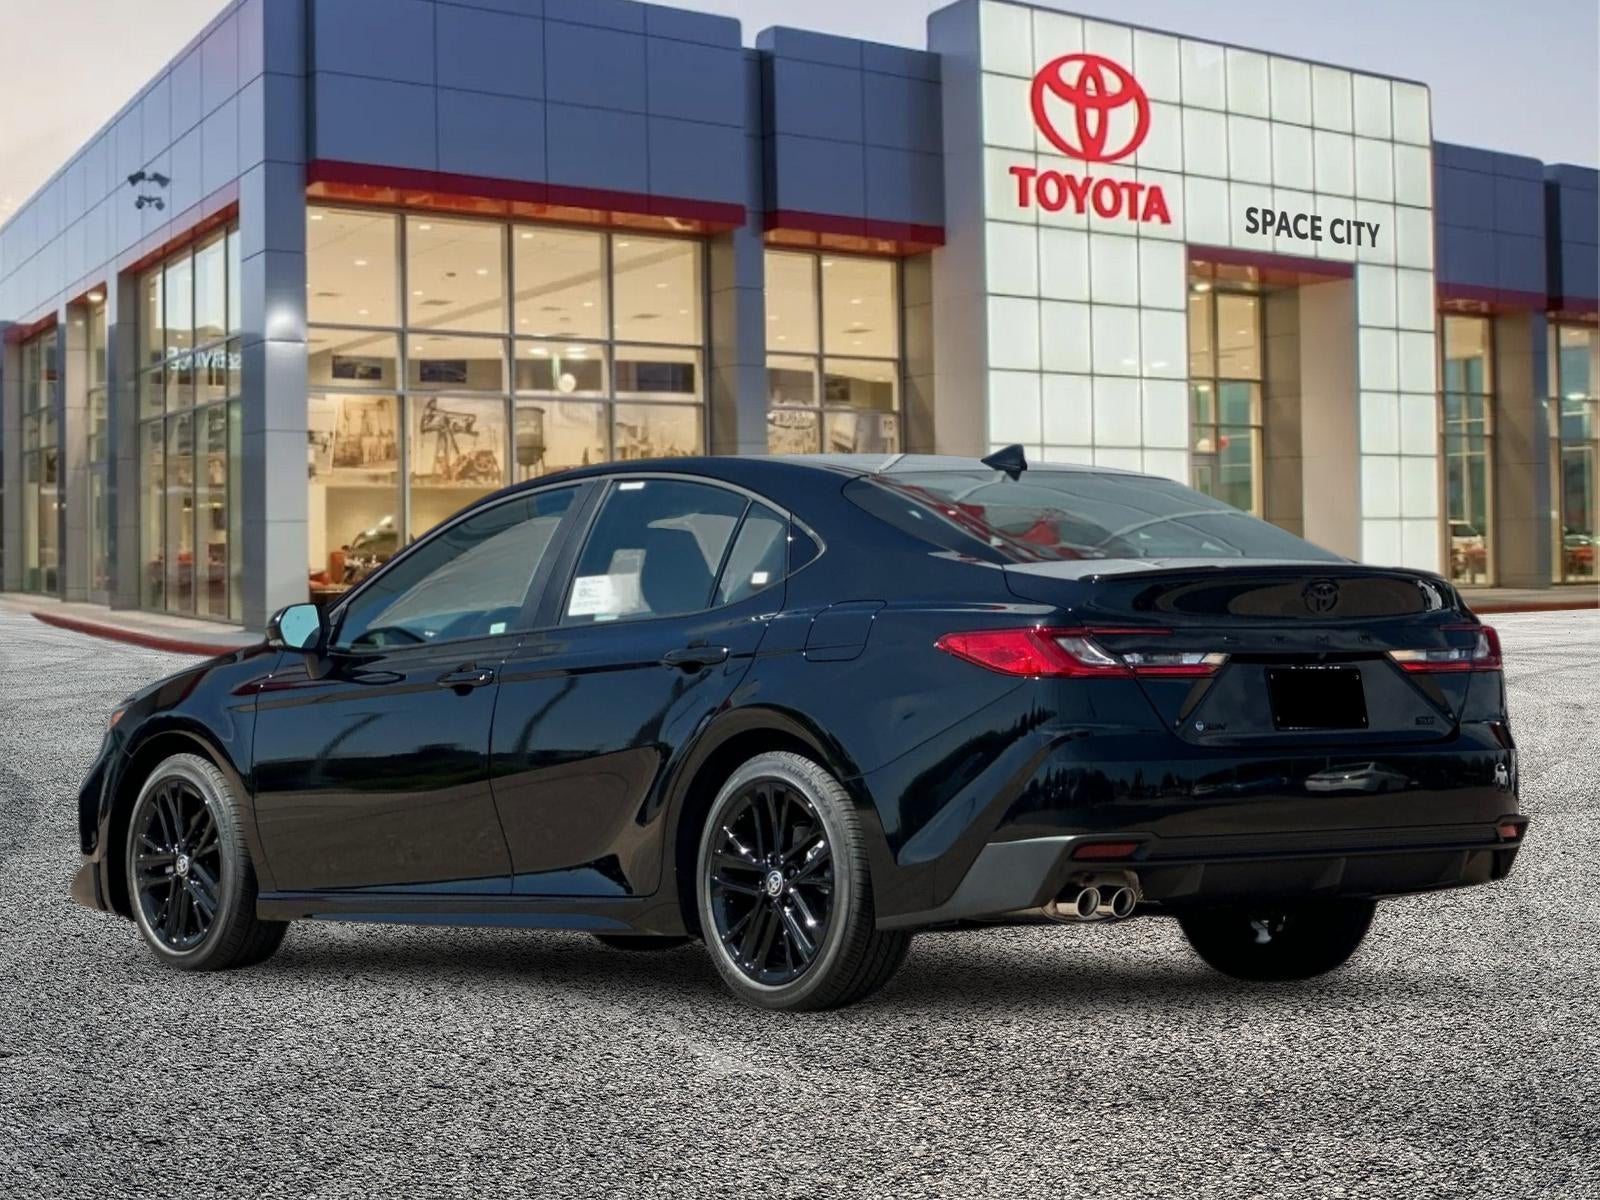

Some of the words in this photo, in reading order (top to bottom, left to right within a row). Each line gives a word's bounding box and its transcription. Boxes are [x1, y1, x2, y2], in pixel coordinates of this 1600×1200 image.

[1009, 166, 1171, 225] TOYOTA
[1245, 206, 1322, 241] SPACE
[1329, 217, 1380, 248] CITY
